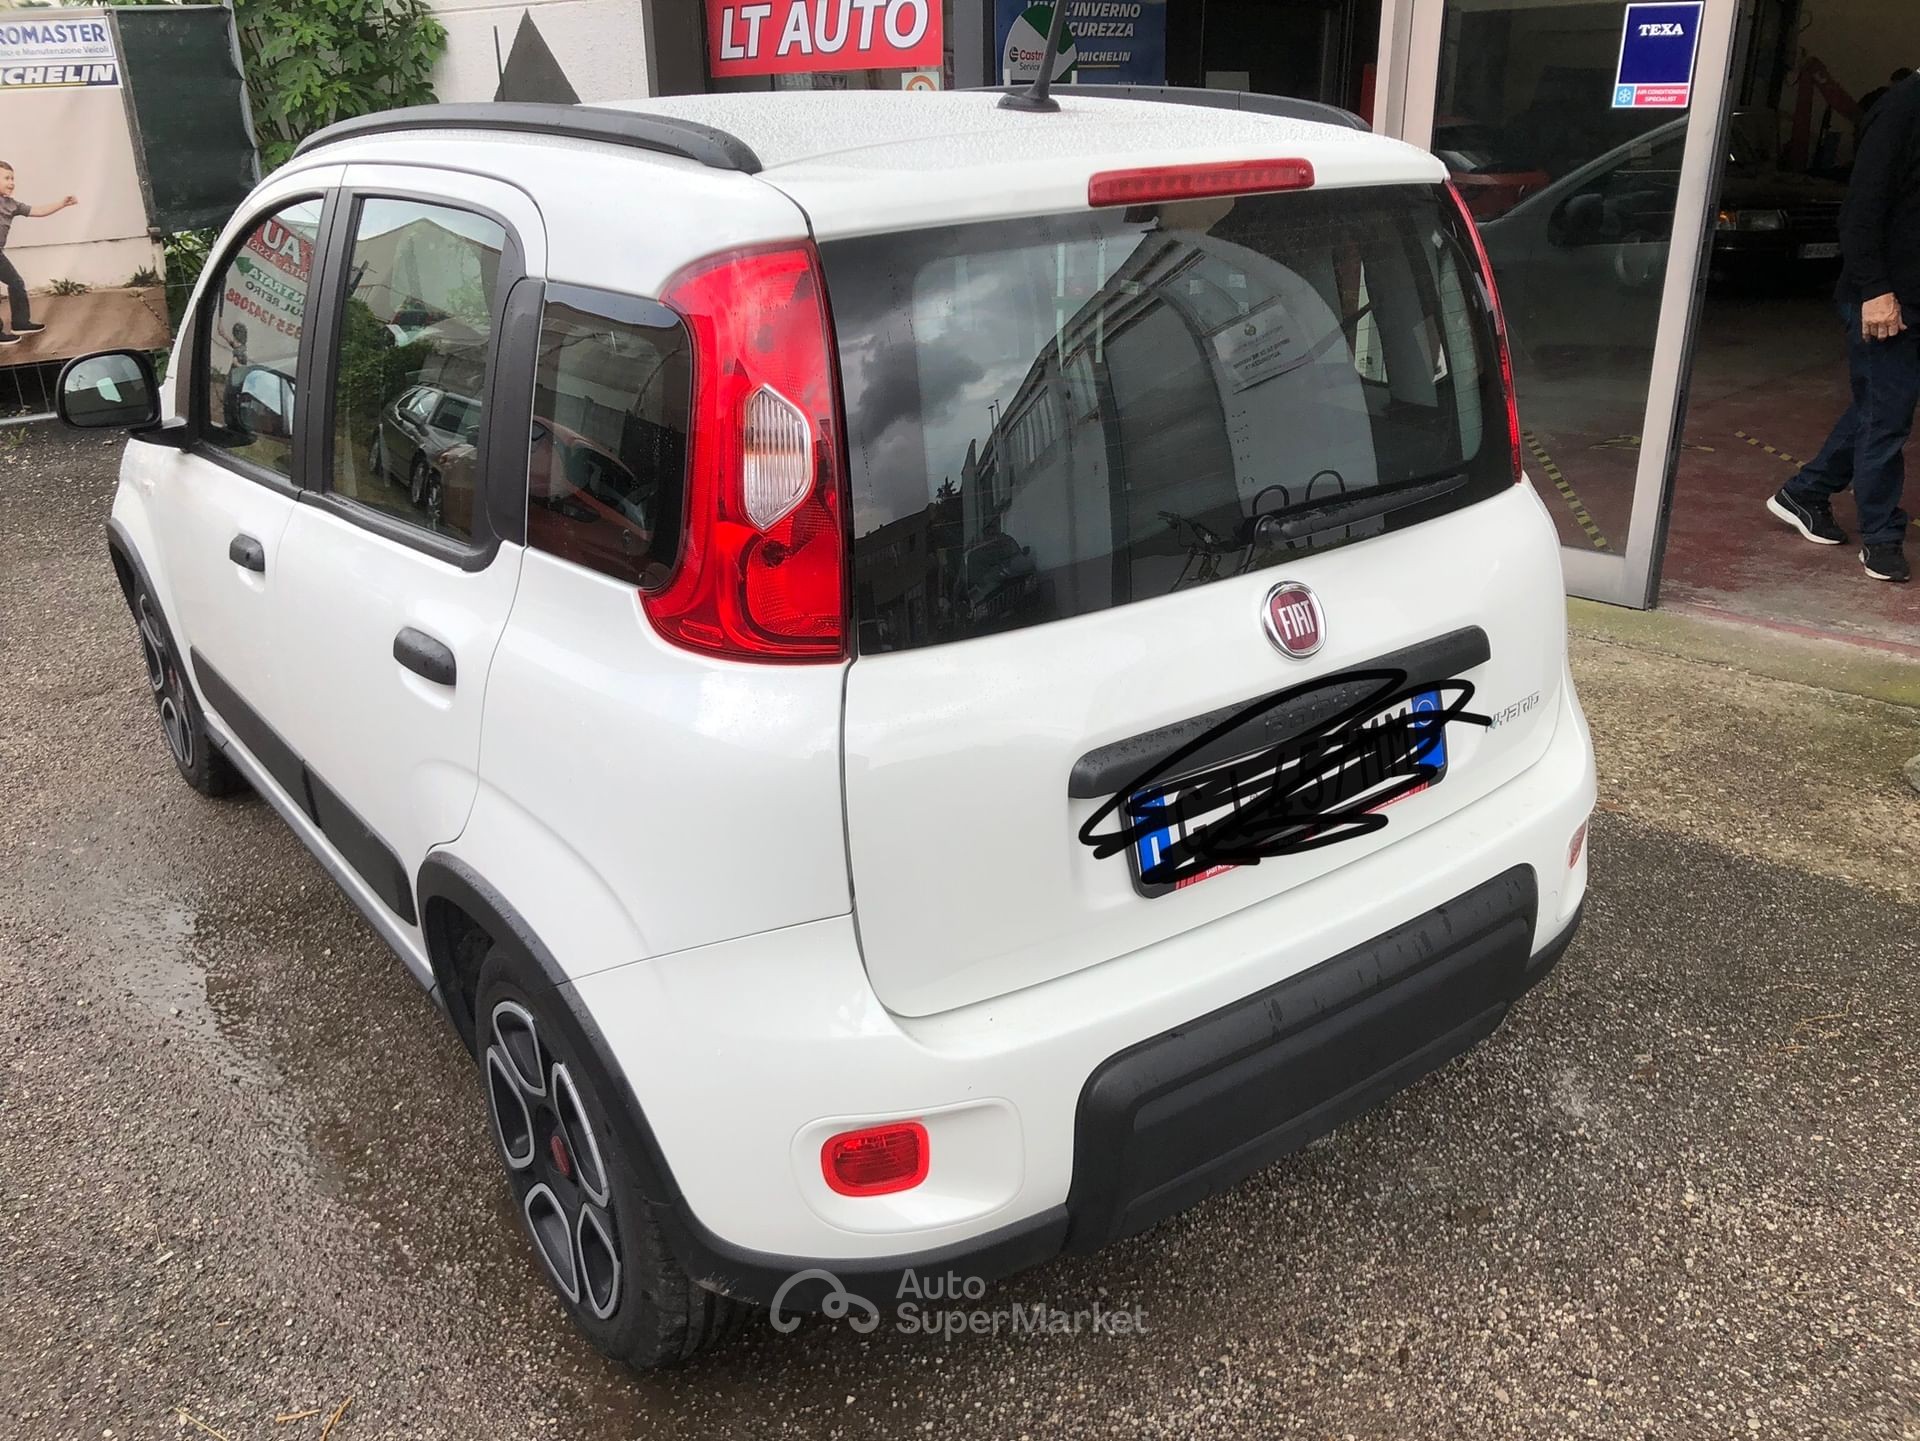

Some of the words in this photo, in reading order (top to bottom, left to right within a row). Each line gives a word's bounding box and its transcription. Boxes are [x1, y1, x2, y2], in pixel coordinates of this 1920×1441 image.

[720, 4, 772, 60] LT
[776, 0, 930, 56] AUTO
[1066, 21, 1135, 38] CUREZZA
[1638, 23, 1684, 36] TEXA
[1077, 51, 1131, 62] MICHELIN
[1277, 600, 1316, 641] FIAT
